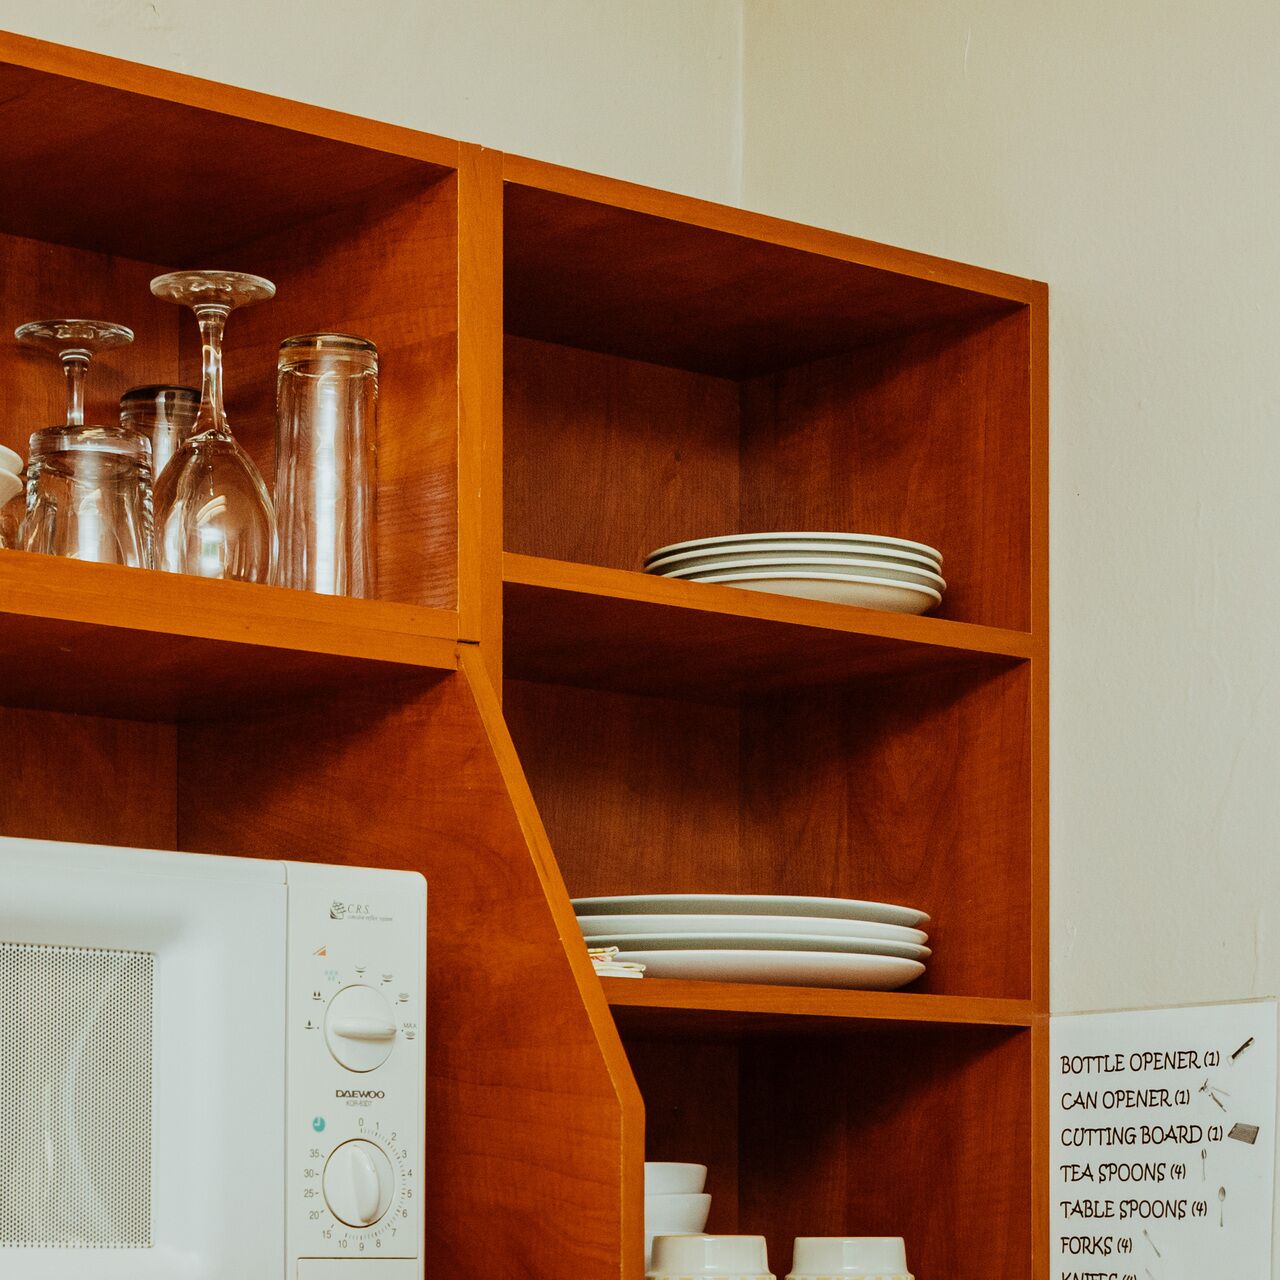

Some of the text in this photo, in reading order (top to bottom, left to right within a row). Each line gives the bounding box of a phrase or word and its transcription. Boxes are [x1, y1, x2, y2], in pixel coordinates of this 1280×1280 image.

[1060, 1051, 1220, 1074] BOTTLE OPENER (1)
[336, 1089, 385, 1099] DAEWOO
[1061, 1089, 1191, 1111] CAN OPENER (1)
[358, 1117, 364, 1127] 0
[375, 1122, 380, 1130] 1
[391, 1132, 397, 1141] 2
[1061, 1125, 1223, 1147] CUTTING BOARD (1)
[309, 1149, 320, 1158] 35
[402, 1150, 407, 1159] 3
[304, 1169, 314, 1178] 30
[407, 1169, 413, 1177] 4
[1060, 1163, 1187, 1183] TEA SPOONS (4)
[304, 1189, 314, 1198] 25
[407, 1189, 413, 1199] 5
[402, 1209, 408, 1218] 6
[1060, 1200, 1208, 1220] TABLE SPOONS (4)
[309, 1211, 320, 1220] 20
[322, 1231, 332, 1239] 15
[391, 1228, 397, 1237] 7
[338, 1240, 348, 1249] 10
[359, 1242, 365, 1251] 9
[375, 1239, 381, 1248] 8
[1060, 1236, 1133, 1256] FORKS (4)
